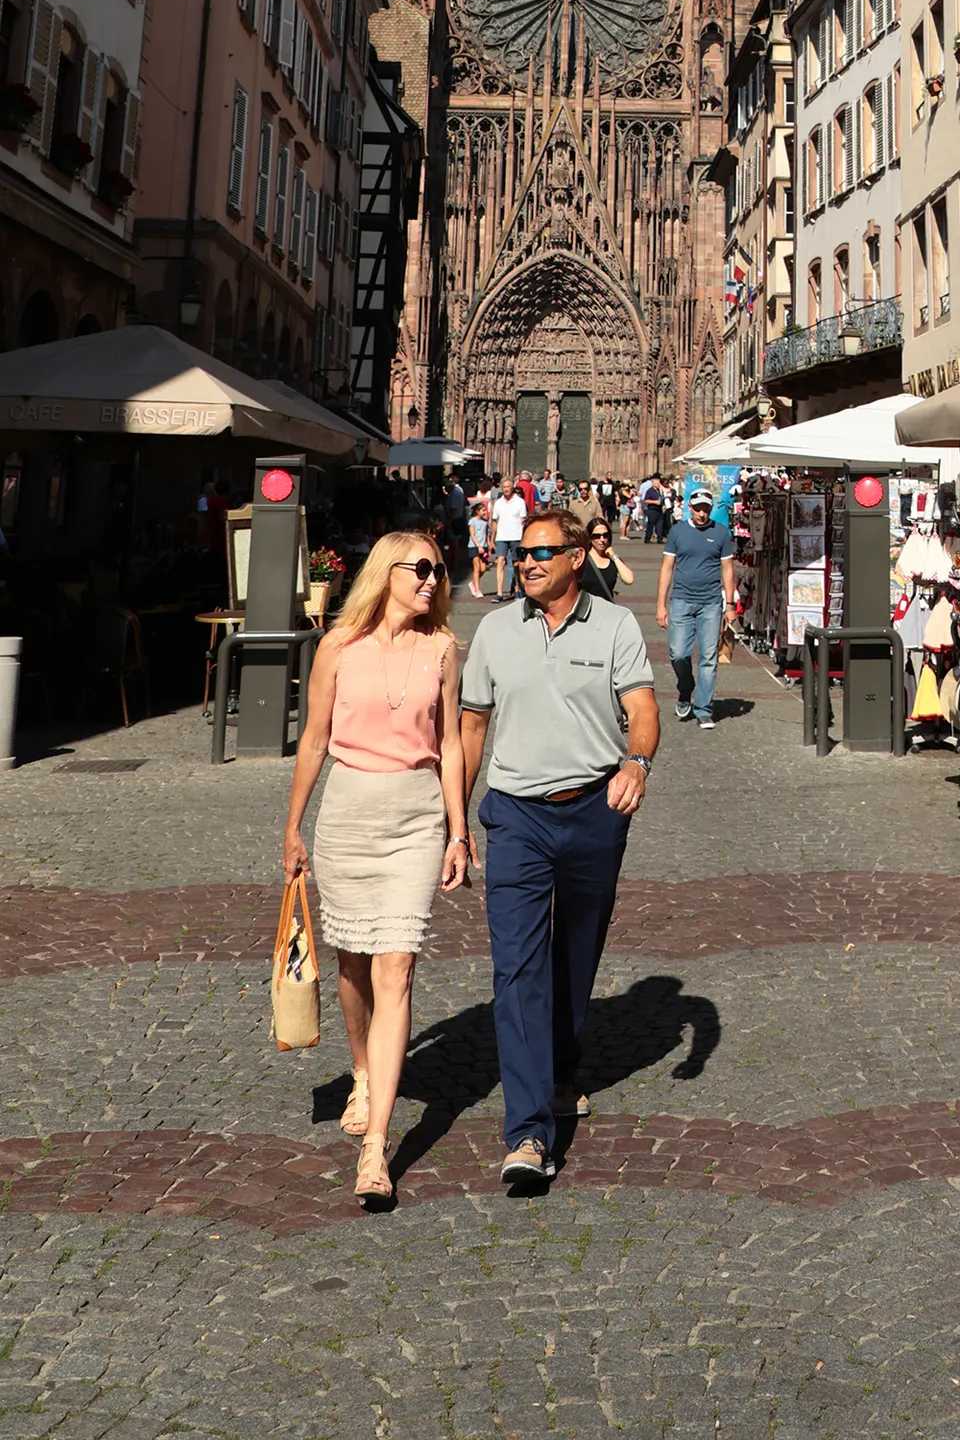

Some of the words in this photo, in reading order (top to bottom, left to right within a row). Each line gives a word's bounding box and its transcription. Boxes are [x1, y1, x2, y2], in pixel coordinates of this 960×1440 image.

[9, 403, 64, 422] CAFE
[100, 405, 218, 427] BRASSERIE
[692, 474, 735, 484] GLACES
